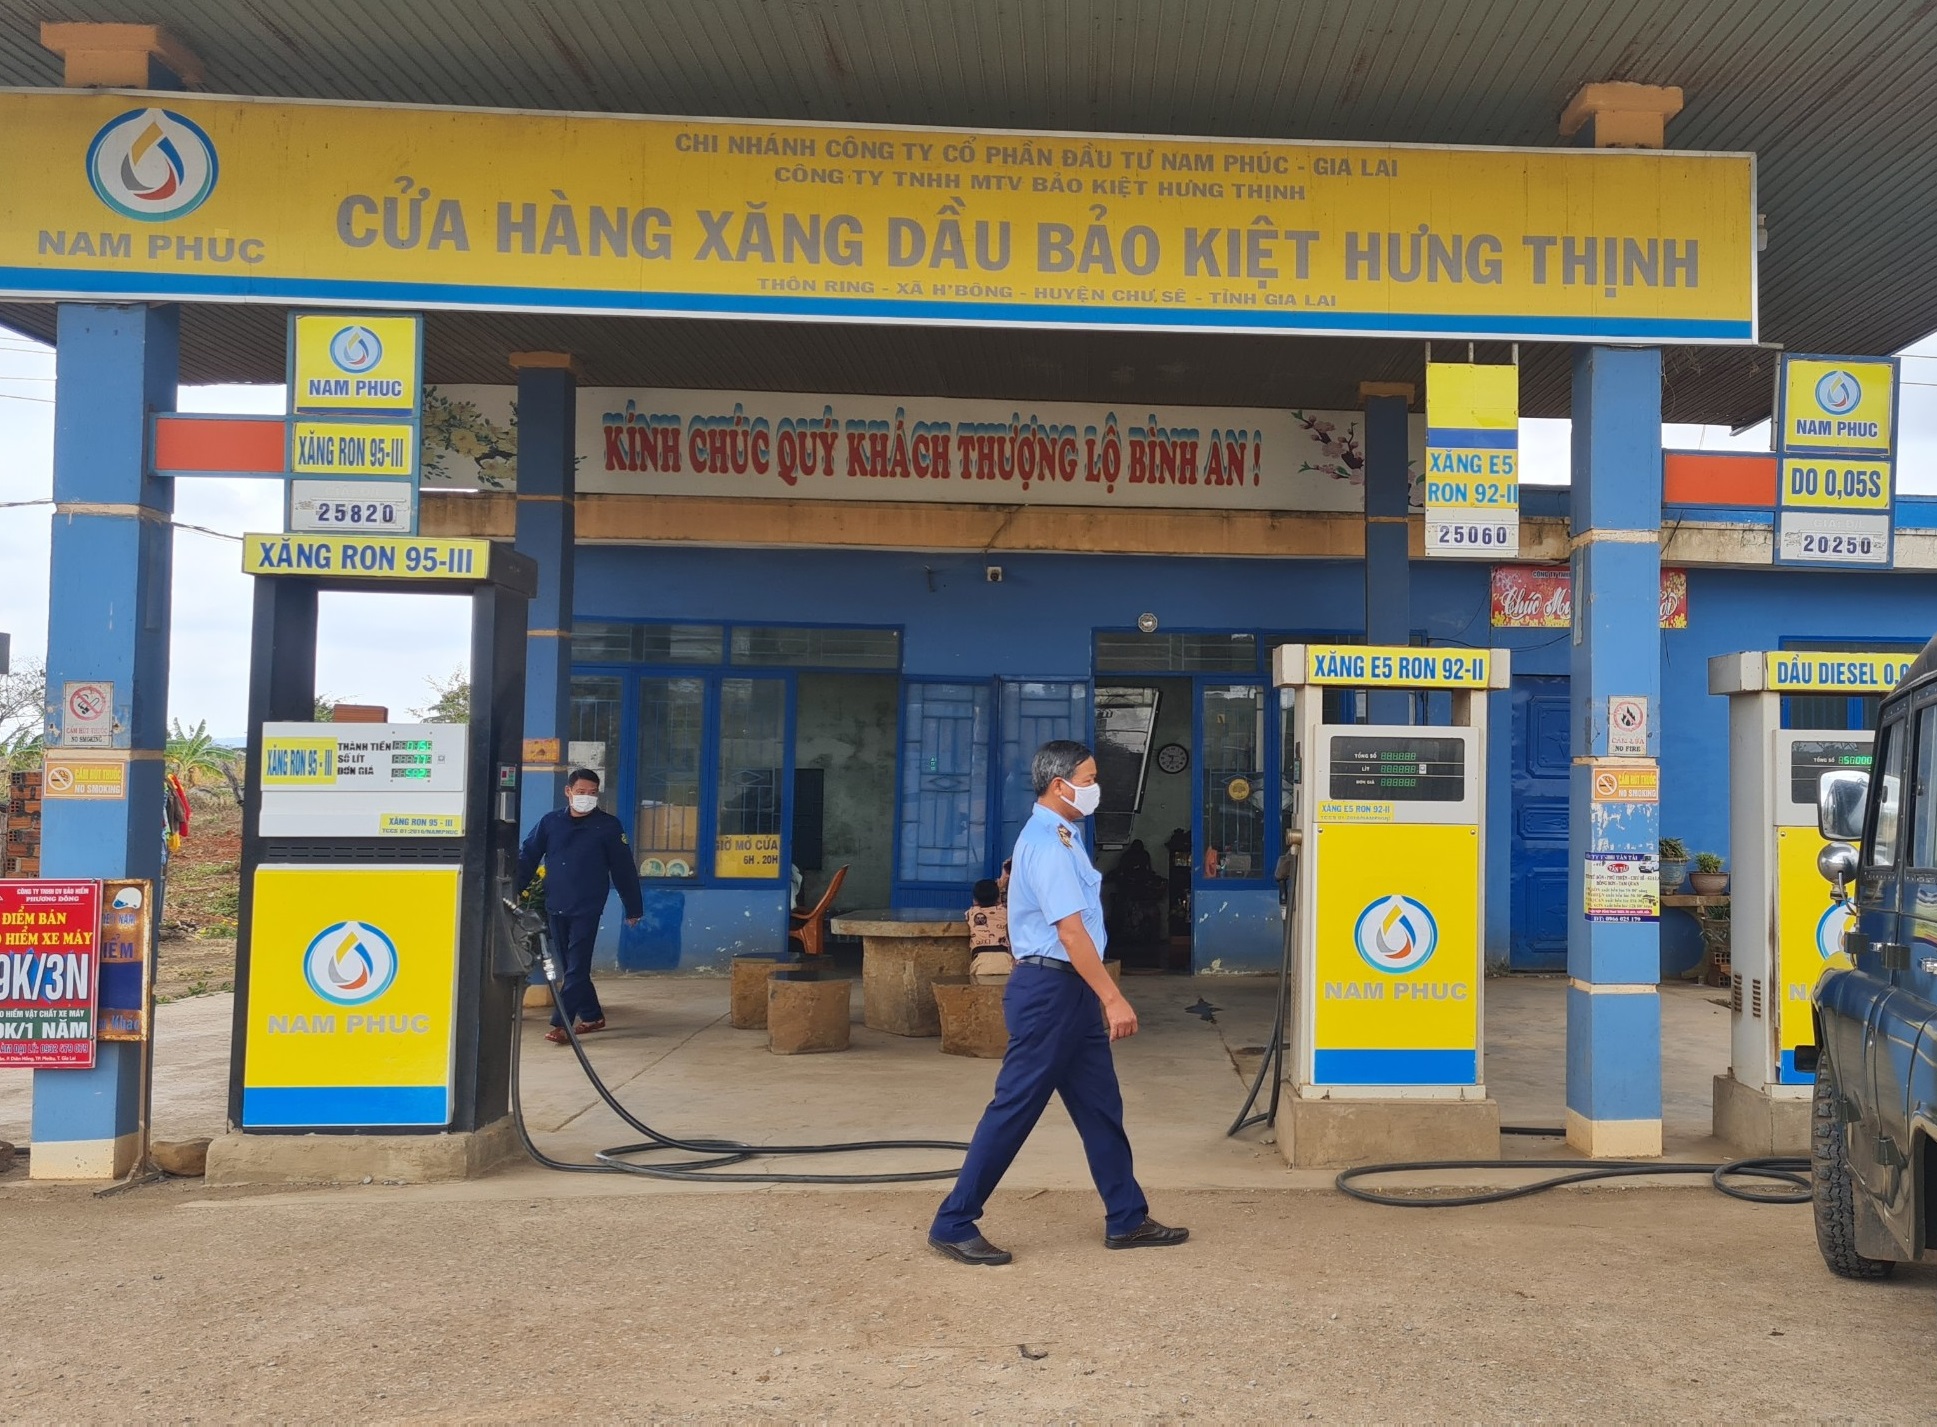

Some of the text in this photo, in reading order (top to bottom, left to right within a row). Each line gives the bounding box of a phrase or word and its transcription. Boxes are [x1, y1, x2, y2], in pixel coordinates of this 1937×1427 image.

[675, 133, 718, 152] CHI
[728, 132, 815, 156] NHÁNH
[826, 136, 893, 160] CÔNG
[902, 142, 934, 161] TY
[943, 136, 975, 163] CỔ
[986, 140, 1052, 166] PHẦN
[1061, 142, 1111, 169] ĐẦU
[1121, 149, 1154, 170] TƯ
[1161, 153, 1214, 172] NAM
[1224, 150, 1288, 174] PHÚC
[1314, 157, 1352, 176] GIA
[1360, 159, 1398, 177] LAI
[775, 164, 1305, 203] CÔNG TY TNHH MTV BẢO KIỆT HƯNG THỊNH
[37, 230, 132, 258] NAM
[336, 176, 1699, 298] CỬA HÀNG XĂNG DẦU BẢO KIỆT HƯNG THỊNH
[757, 276, 816, 292] THÔN
[824, 280, 875, 294] RING
[896, 281, 924, 295] XÃ
[1034, 286, 1105, 302] HUYỆN
[1162, 289, 1186, 303] SÊ
[1209, 288, 1256, 305] TỈNH
[1264, 293, 1297, 306] GIA
[1304, 295, 1336, 307] LAI
[309, 379, 402, 397] NAM PHUC
[1796, 419, 1878, 438] NAM PHUC
[298, 430, 404, 467] XĂNG RON 95-III
[602, 400, 682, 473] KÍNH
[688, 404, 770, 475] CHÚC
[777, 404, 839, 486] QUÝ
[846, 408, 951, 481] KHÁCH
[957, 414, 1078, 490] THƯỢNG
[1084, 412, 1122, 494] LỘ
[1128, 413, 1199, 486] BÌNH
[1204, 429, 1248, 487] AN
[1429, 450, 1514, 475] XĂNG E5
[1428, 482, 1519, 506] RON 92-II
[1791, 468, 1881, 499] DO 0,05S
[318, 503, 393, 523] 25820
[1438, 524, 1508, 545] 25060
[1803, 534, 1871, 555] 20250
[259, 538, 473, 574] XĂNG RON 95-III
[1315, 651, 1483, 681] XĂNG E5 RON 92-II
[1778, 654, 1878, 685] DẦU DIESEL
[337, 741, 368, 751] THÀNH
[267, 743, 287, 776] XĂNG
[290, 750, 306, 776] RON
[308, 750, 317, 776] 95
[75, 784, 121, 794] NO SMOKING
[1628, 789, 1656, 798] SMOKING
[1322, 803, 1341, 812] XĂNG
[389, 816, 409, 826] XĂNG
[743, 855, 779, 865] 6H 20H
[2, 906, 67, 925] ĐIỂM BÁN
[5, 926, 39, 946] HIỂM
[42, 932, 60, 946] XE
[63, 929, 93, 946] MÁY
[103, 934, 134, 958] IỂM
[1325, 982, 1468, 1000] NAM PHUC
[6, 1007, 23, 1018] HIỂM
[69, 1008, 85, 1017] MÁY
[42, 1019, 88, 1039] NĂM
[268, 1014, 430, 1034] NAM PHUC
